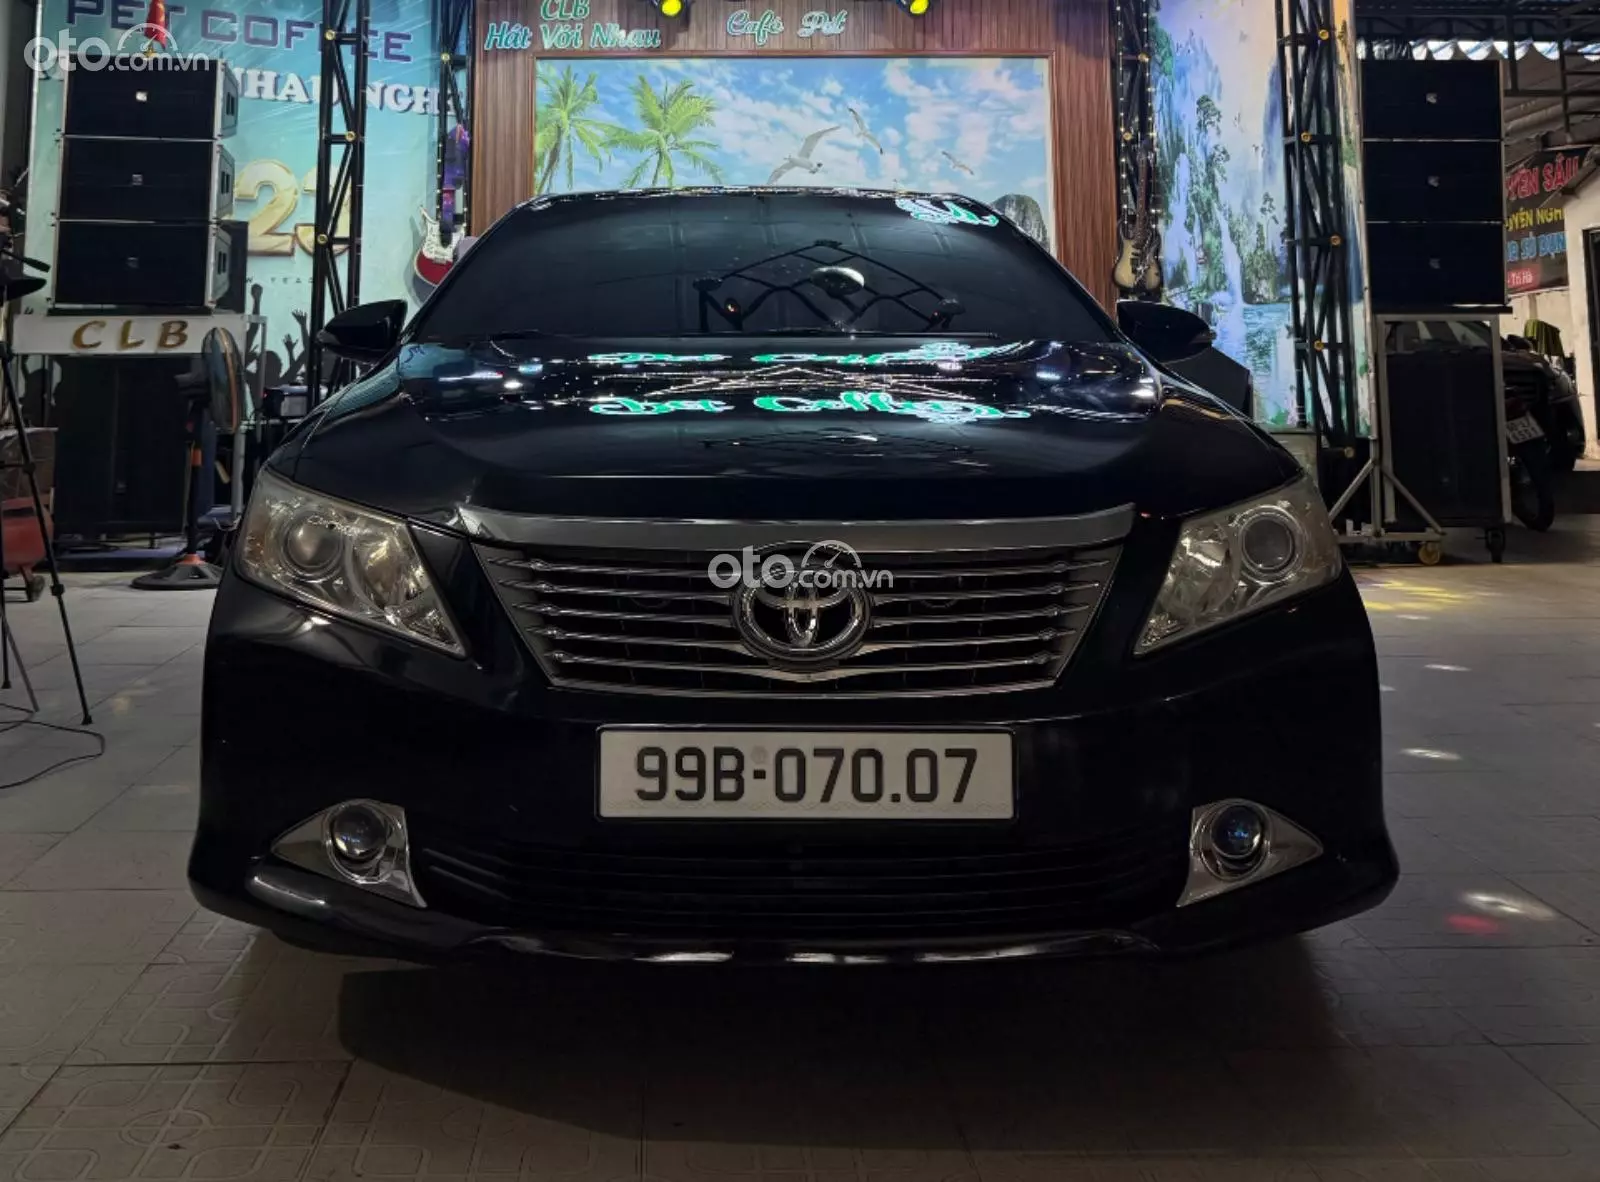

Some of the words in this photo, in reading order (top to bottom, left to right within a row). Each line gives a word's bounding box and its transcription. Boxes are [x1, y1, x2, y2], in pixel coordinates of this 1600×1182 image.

[540, 0, 590, 21] CLB
[200, 10, 414, 62] COFEE
[484, 21, 533, 50] Hát
[539, 23, 584, 50] Với
[590, 23, 662, 49] Nhau
[72, 319, 188, 350] CLB
[636, 746, 978, 803] 99B-070.07
